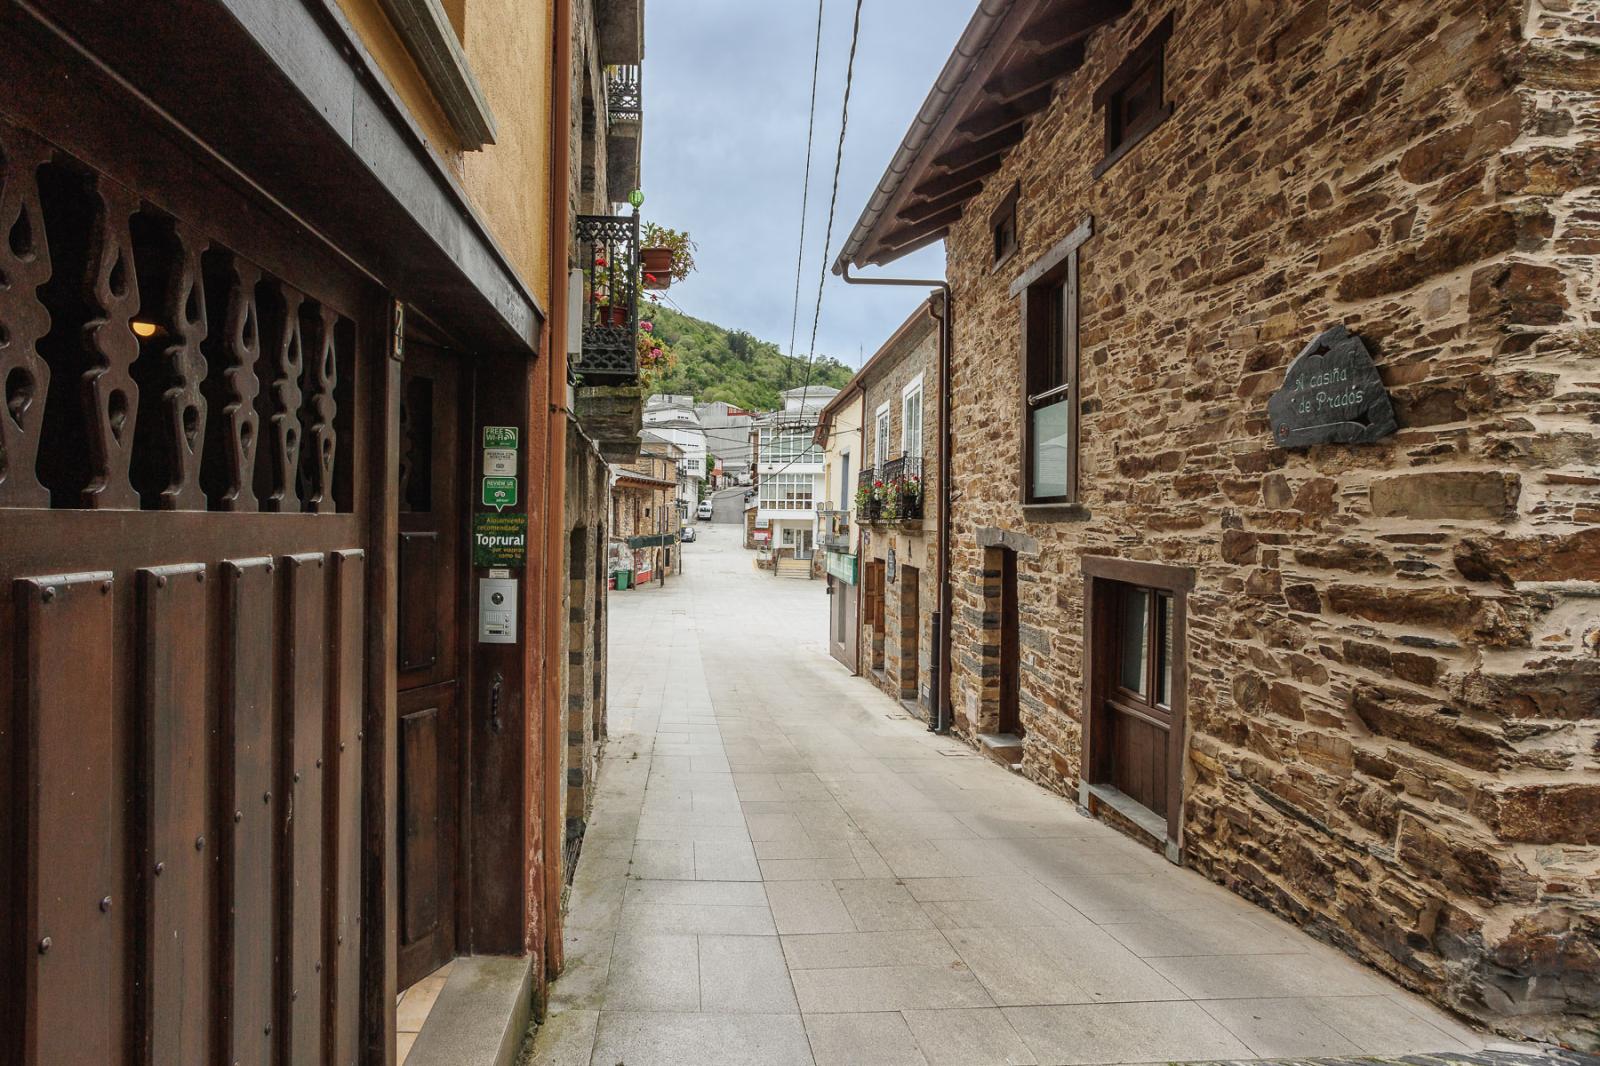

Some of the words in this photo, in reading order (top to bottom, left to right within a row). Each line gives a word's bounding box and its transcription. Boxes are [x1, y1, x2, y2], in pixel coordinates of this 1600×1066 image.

[1294, 374, 1304, 392] A
[1310, 367, 1348, 388] casiña
[1298, 396, 1312, 414] de
[1316, 386, 1364, 411] Prados
[476, 533, 525, 548] Toprural
